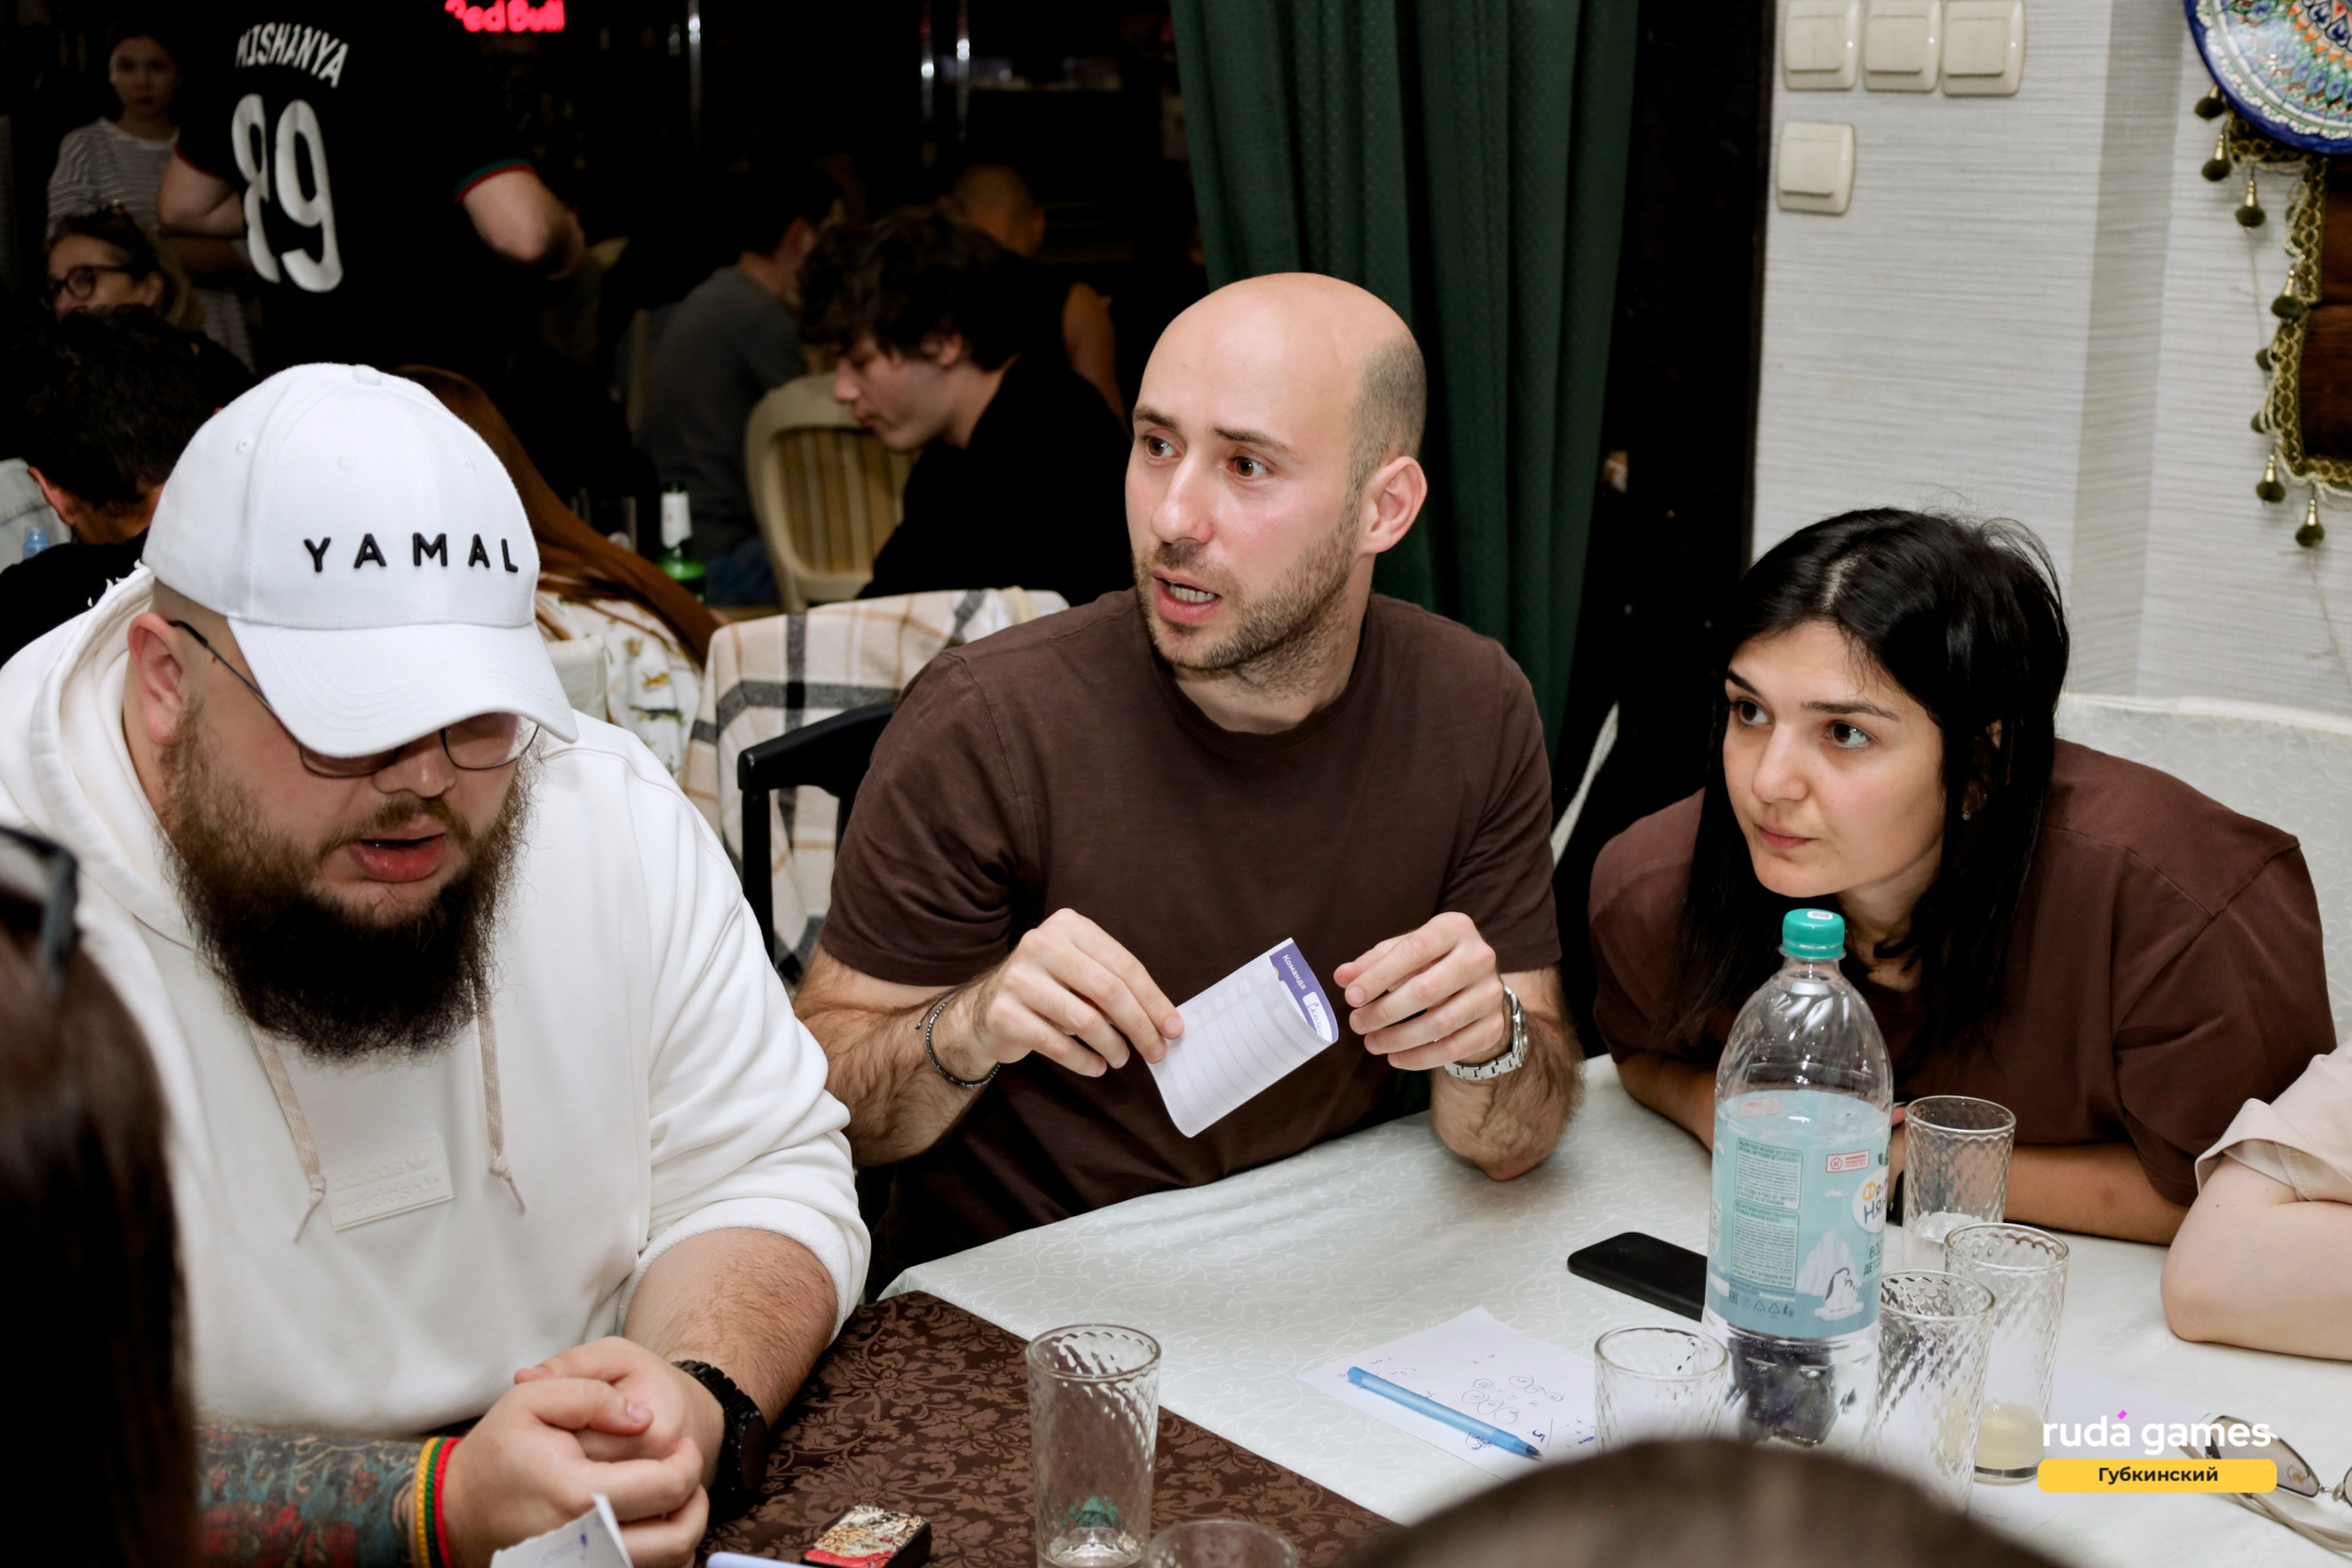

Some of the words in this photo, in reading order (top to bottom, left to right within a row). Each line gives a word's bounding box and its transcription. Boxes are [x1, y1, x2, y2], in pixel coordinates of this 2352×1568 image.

[303, 532, 519, 574] YAMAL
[1282, 953, 1306, 990] Команда
[337, 1185, 413, 1216] adidas
